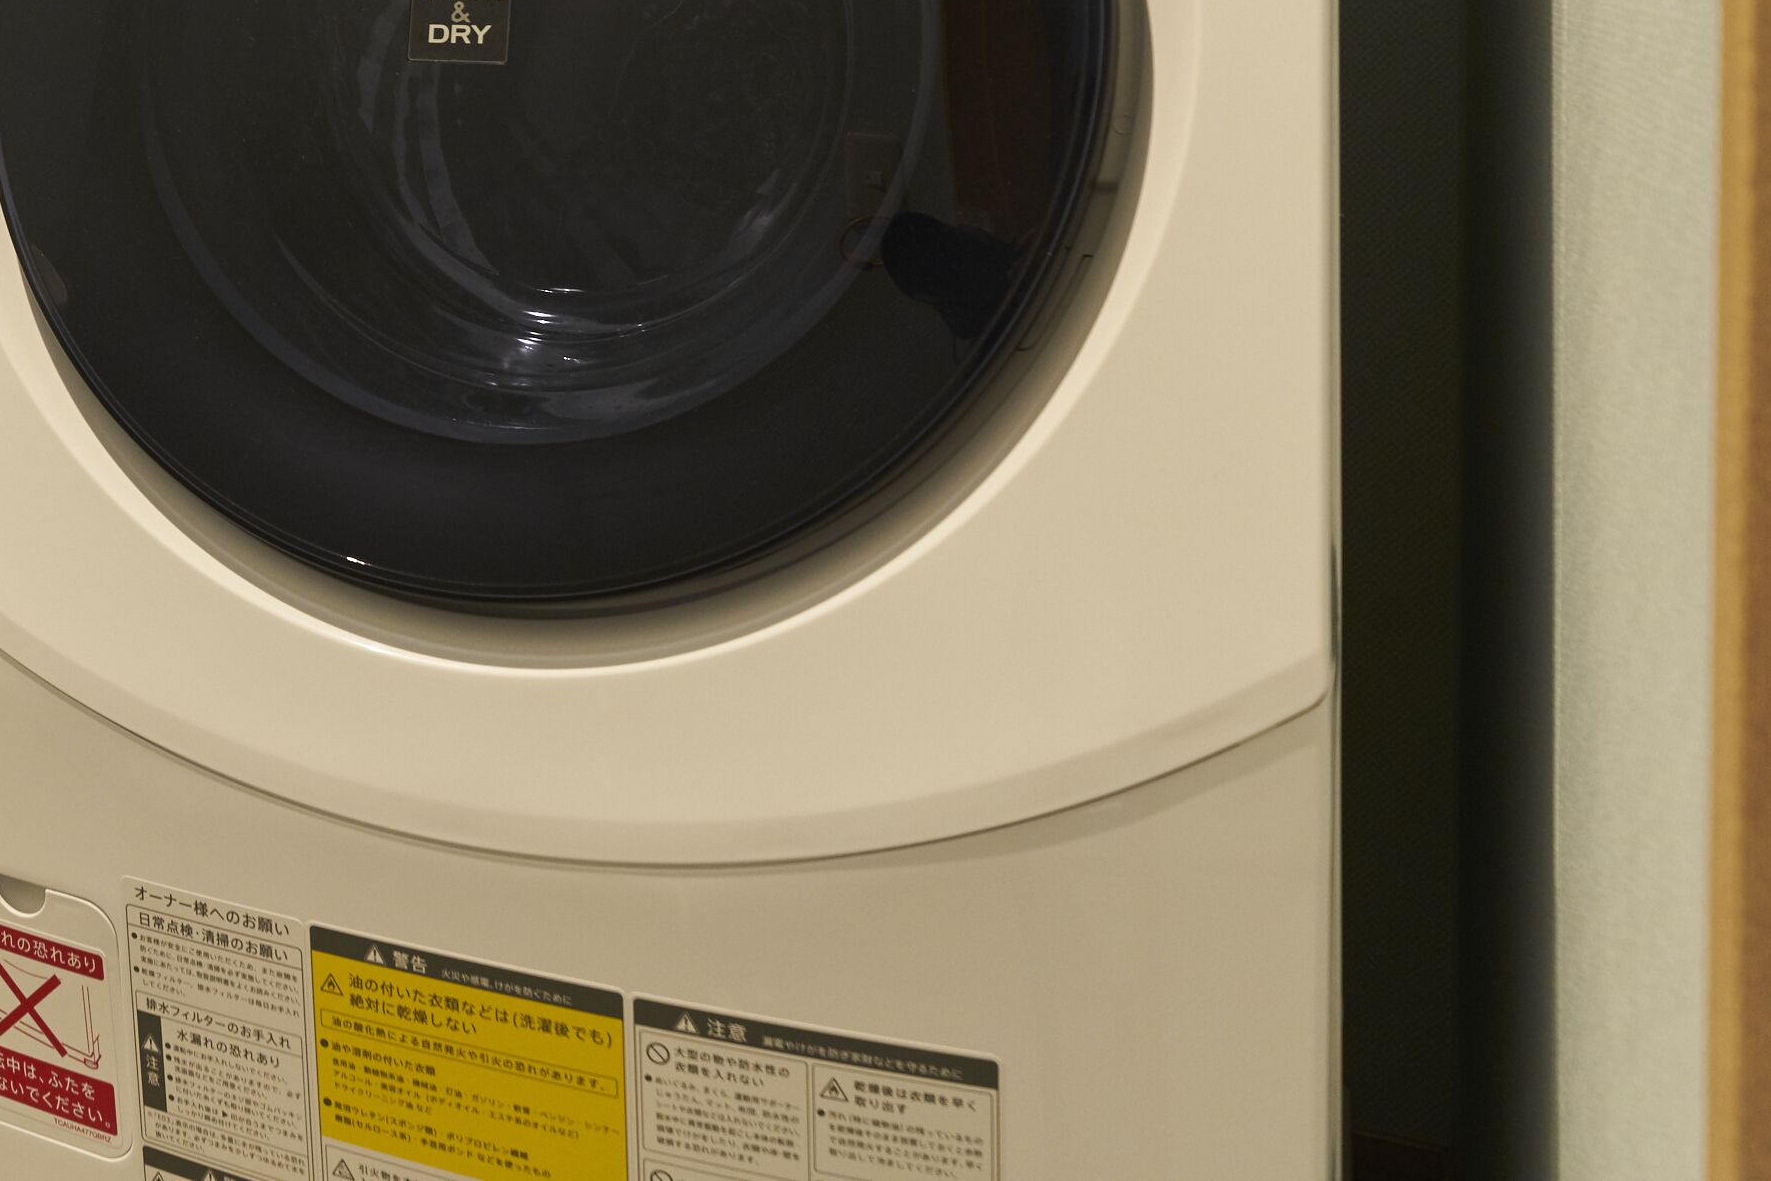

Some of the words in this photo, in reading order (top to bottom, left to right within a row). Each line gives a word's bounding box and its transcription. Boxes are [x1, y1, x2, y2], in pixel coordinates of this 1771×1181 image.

[450, 0, 471, 23] &
[428, 23, 492, 45] DRY
[134, 886, 290, 936] オーナー様へのお願い
[139, 911, 289, 961] 日常点検・清掃のお願い
[392, 950, 428, 974] 警告
[144, 996, 293, 1051] 排水フィルターのお手入れ
[349, 993, 478, 1035] 絶対に乾燥しない
[706, 1018, 749, 1043] 注意
[177, 1029, 280, 1068] 水漏れの恐れあり
[145, 1054, 160, 1087] 注意
[674, 1061, 765, 1088] 衣類を入れない
[853, 1078, 978, 1113] 乾燥後は衣類を早く
[853, 1095, 908, 1116] 取り出す
